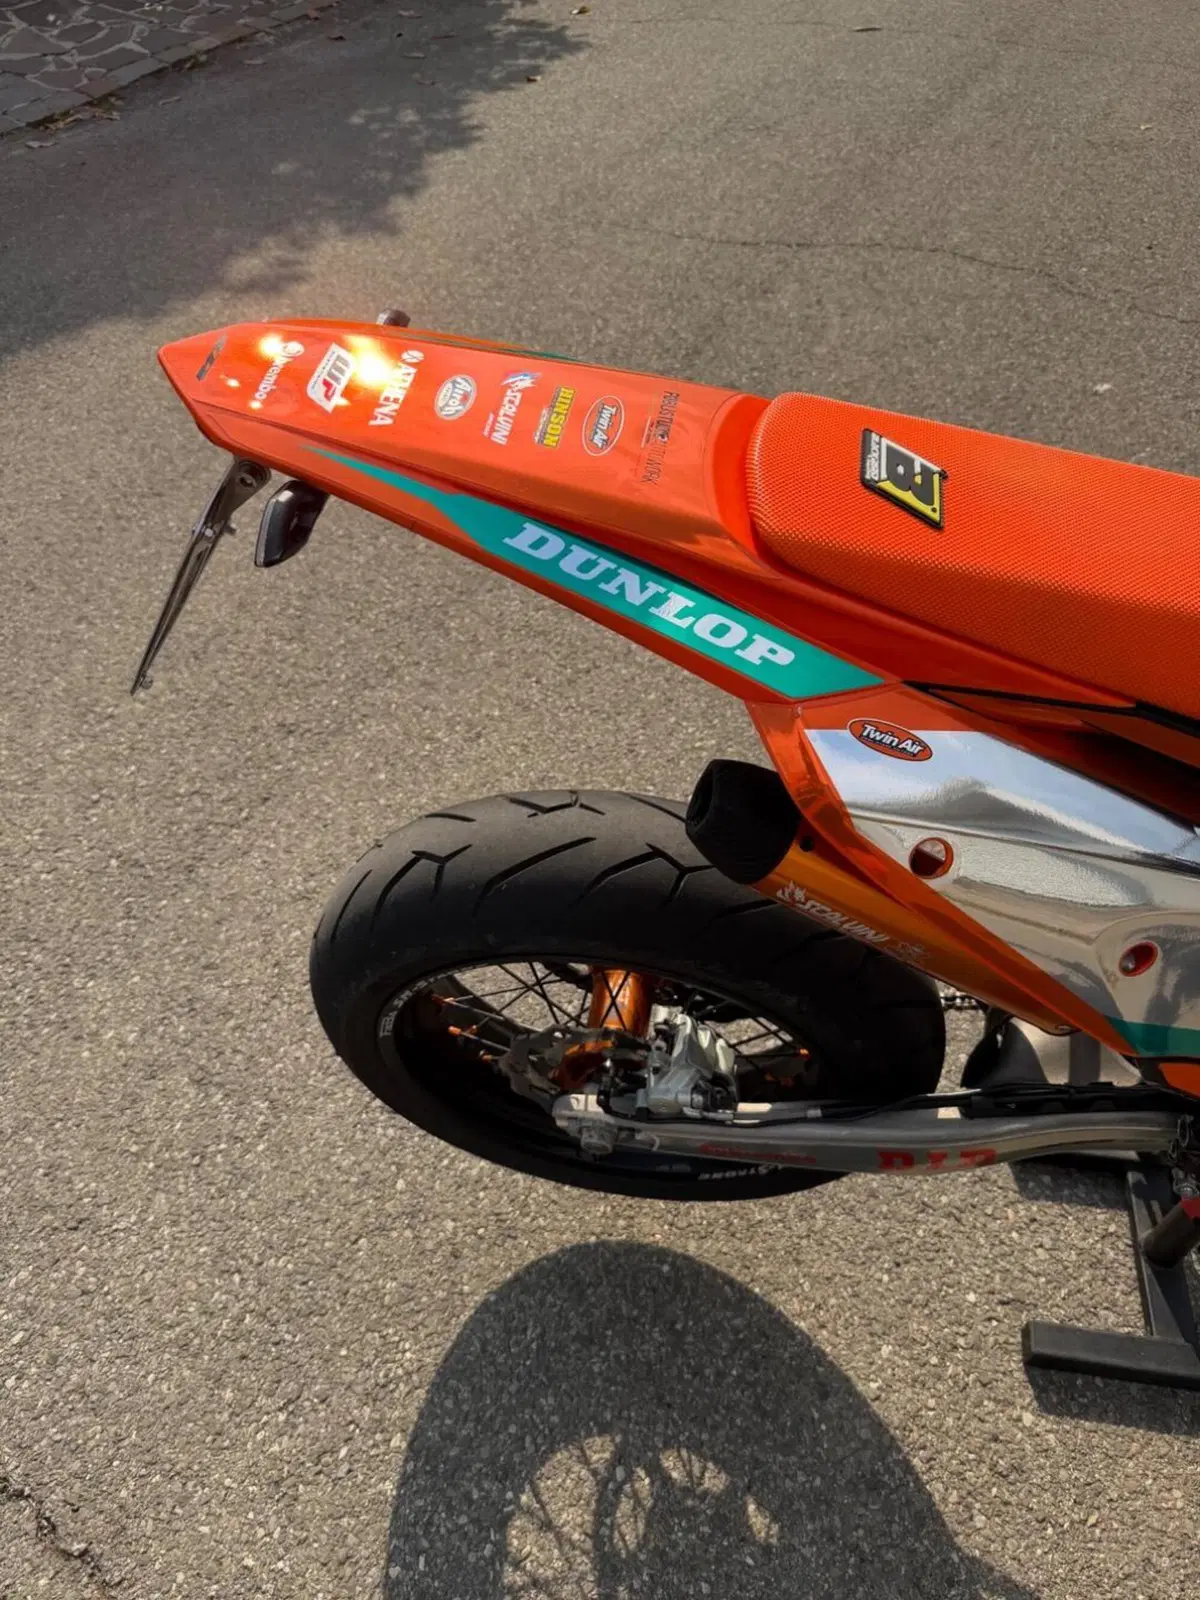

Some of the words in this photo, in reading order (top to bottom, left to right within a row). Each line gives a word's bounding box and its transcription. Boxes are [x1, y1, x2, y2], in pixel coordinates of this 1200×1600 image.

[368, 361, 417, 426] ATHENA
[542, 386, 575, 447] HINSON
[502, 521, 795, 666] DUNLOP
[862, 724, 899, 746] Twin
[898, 738, 924, 754] Air
